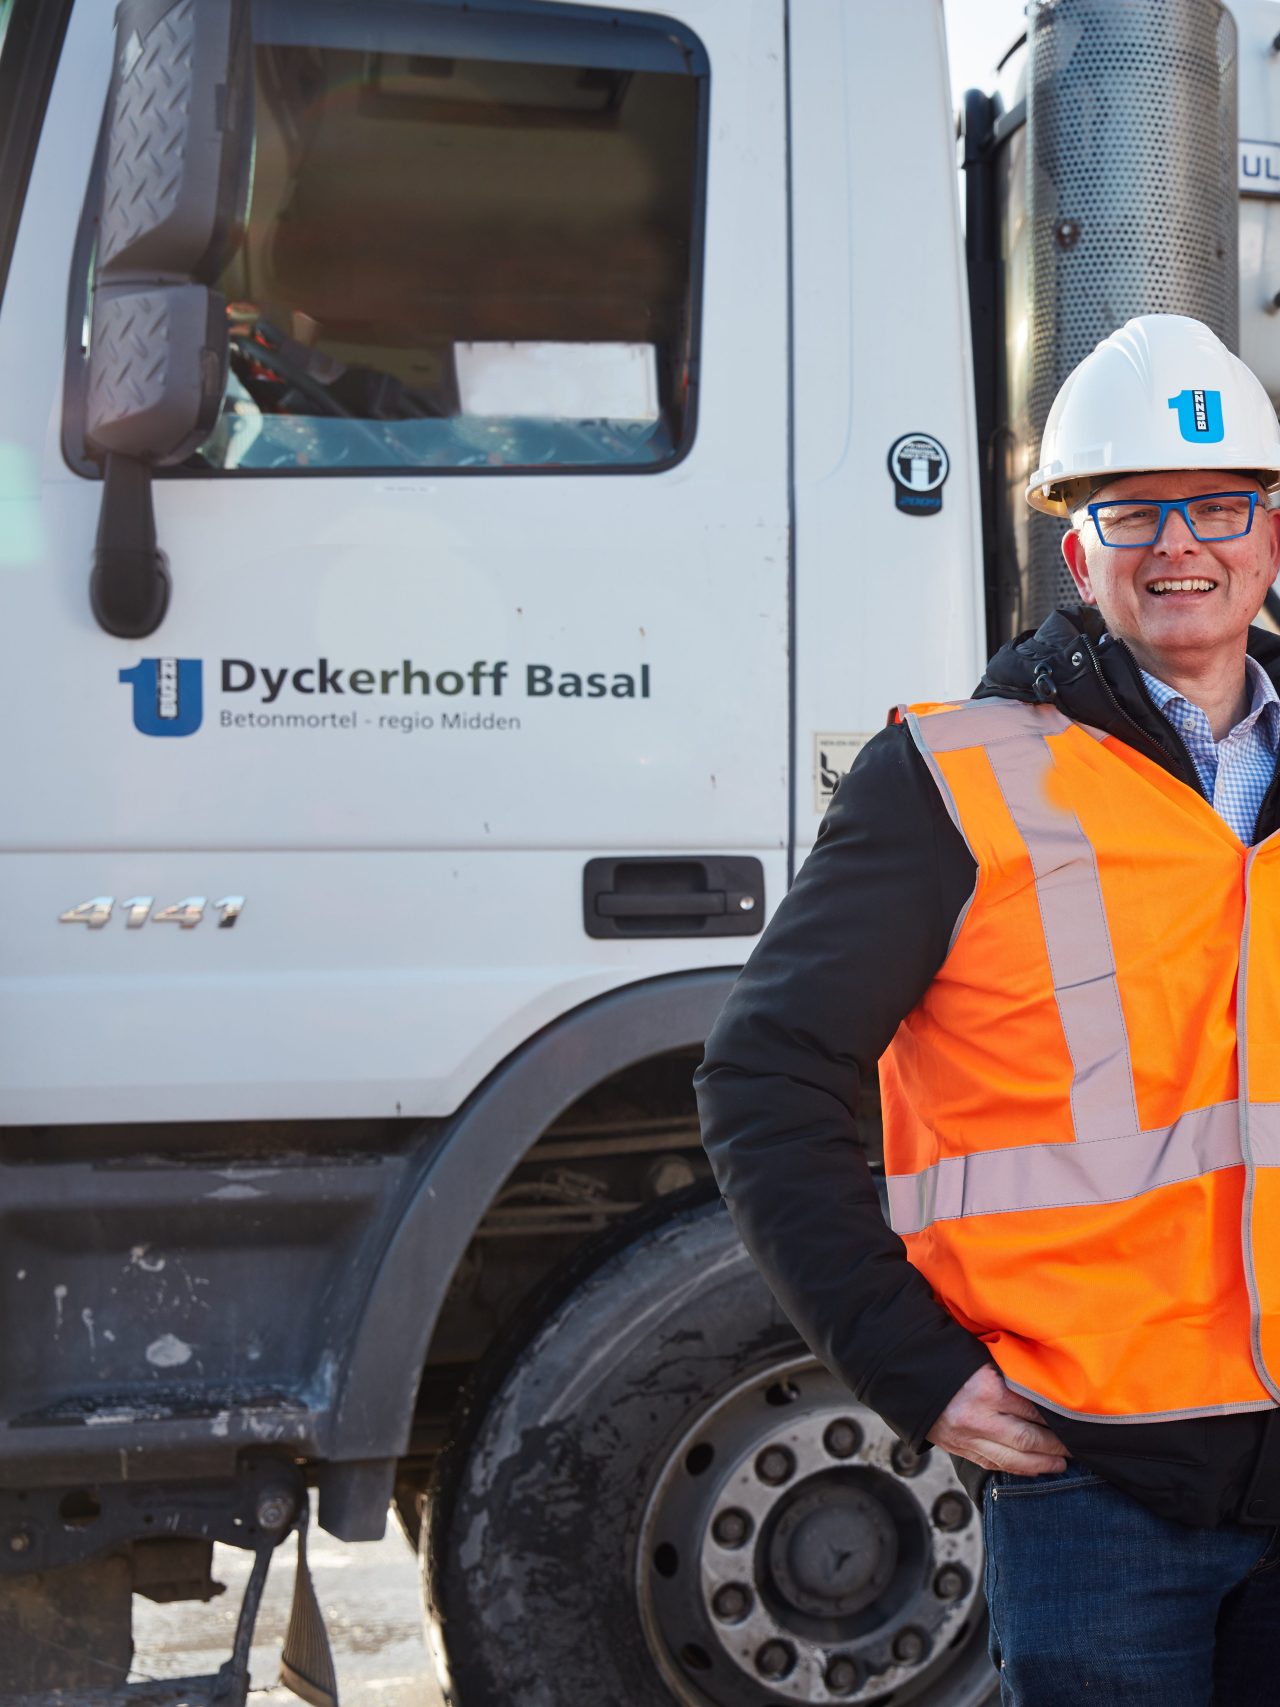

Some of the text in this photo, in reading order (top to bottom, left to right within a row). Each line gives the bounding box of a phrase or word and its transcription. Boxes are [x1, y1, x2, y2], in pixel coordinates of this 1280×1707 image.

[1193, 390, 1207, 430] BUZZI
[221, 658, 509, 704] Dyckerhoff
[526, 663, 650, 699] Basal
[219, 709, 358, 730] Betonmortel
[378, 712, 434, 734] regio
[441, 712, 521, 732] Midden
[57, 895, 246, 931] 4141
